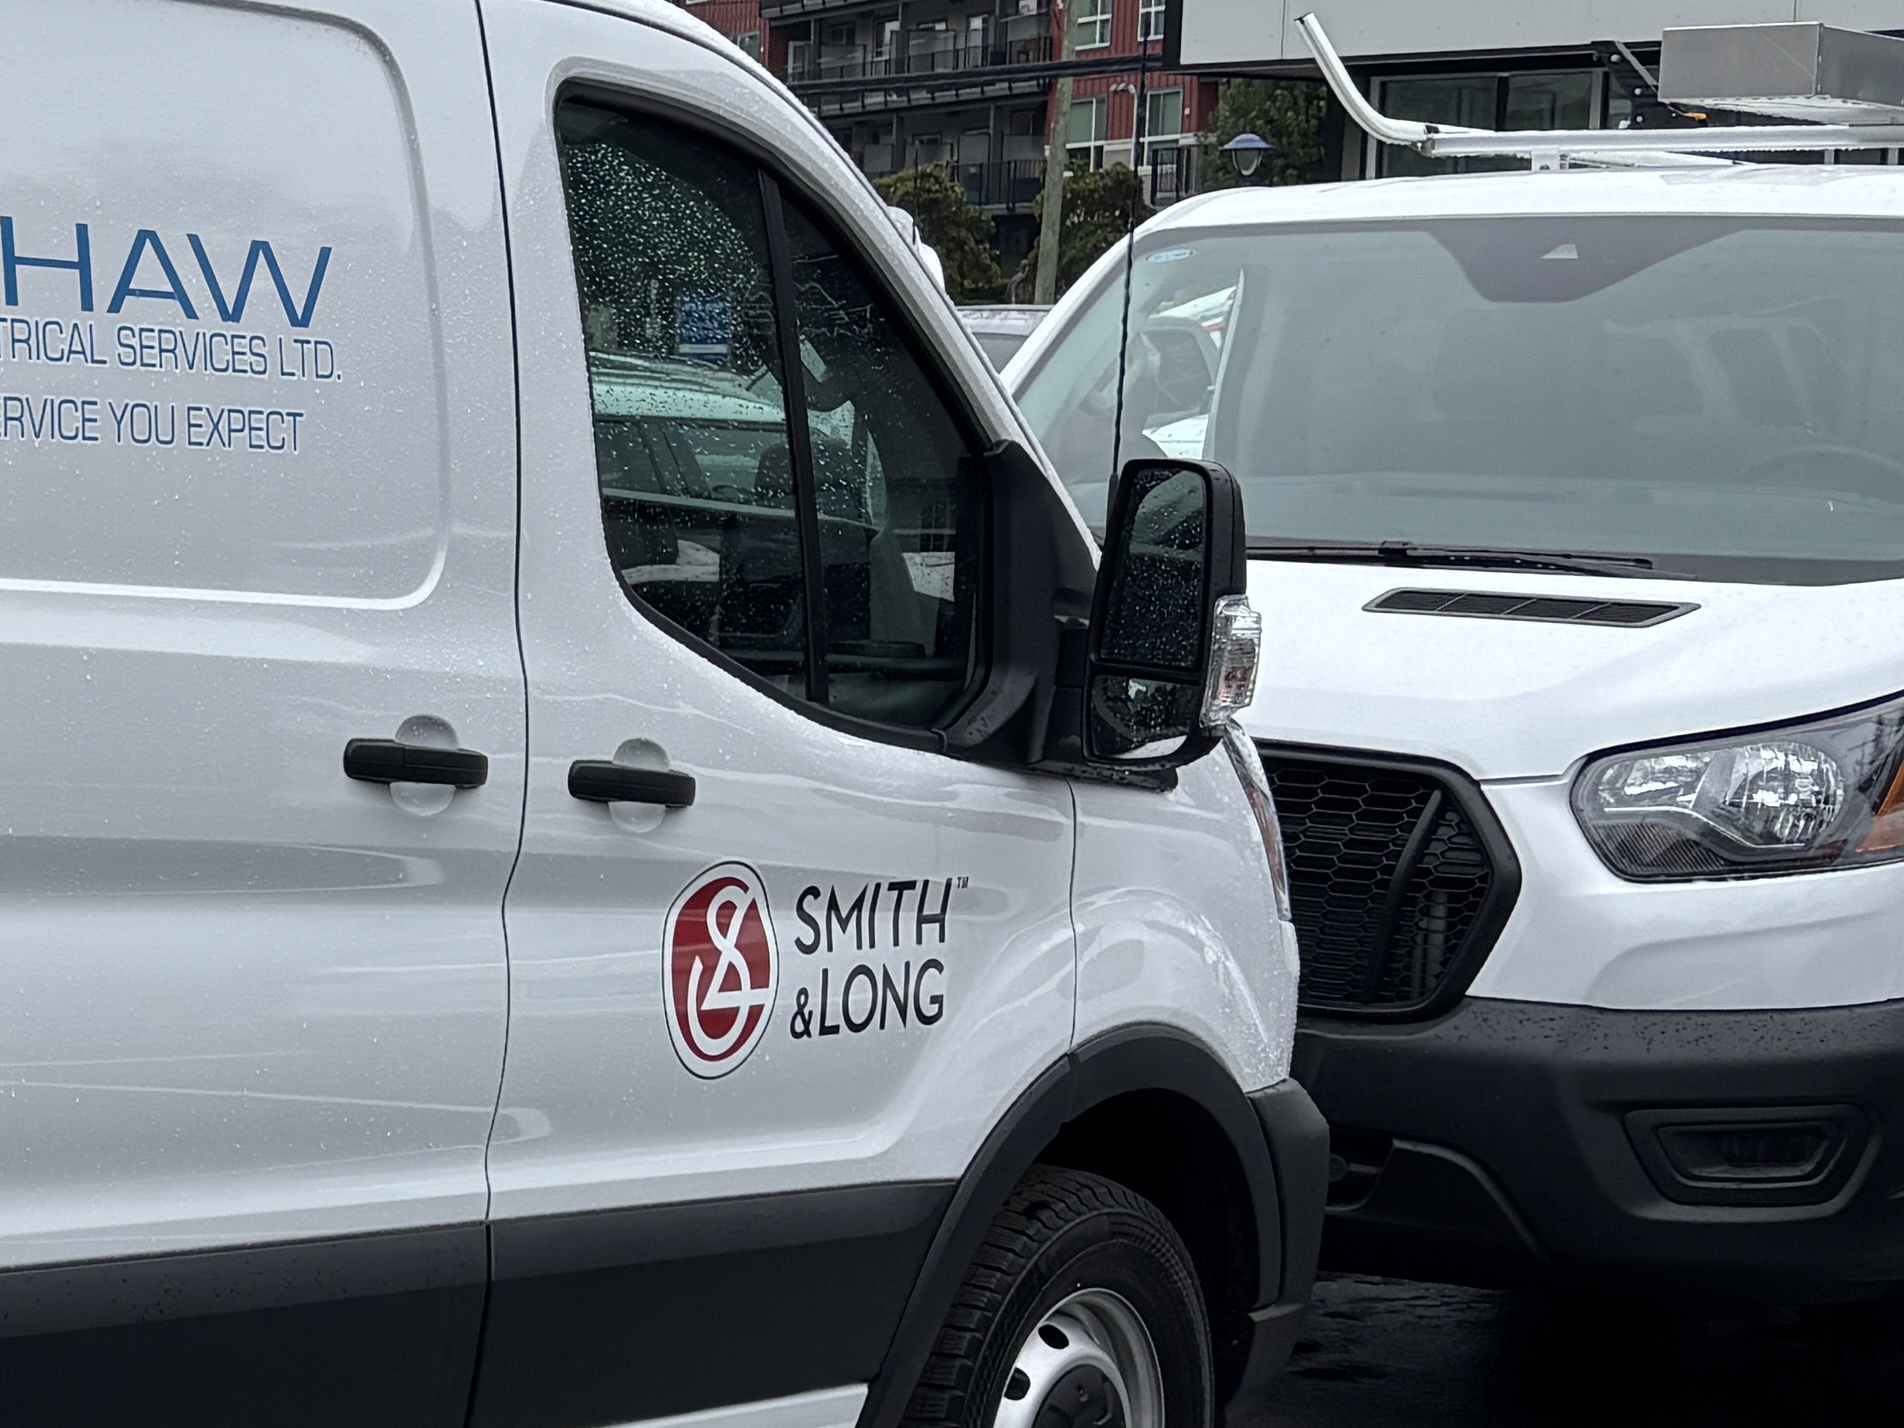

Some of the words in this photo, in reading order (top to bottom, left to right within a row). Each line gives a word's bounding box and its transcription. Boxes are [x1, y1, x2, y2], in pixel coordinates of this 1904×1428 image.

[117, 324, 269, 380] SERVICES
[278, 336, 342, 381] LTD.
[108, 401, 176, 447] YOU
[186, 405, 306, 453] EXPECT
[794, 878, 953, 955] SMITH
